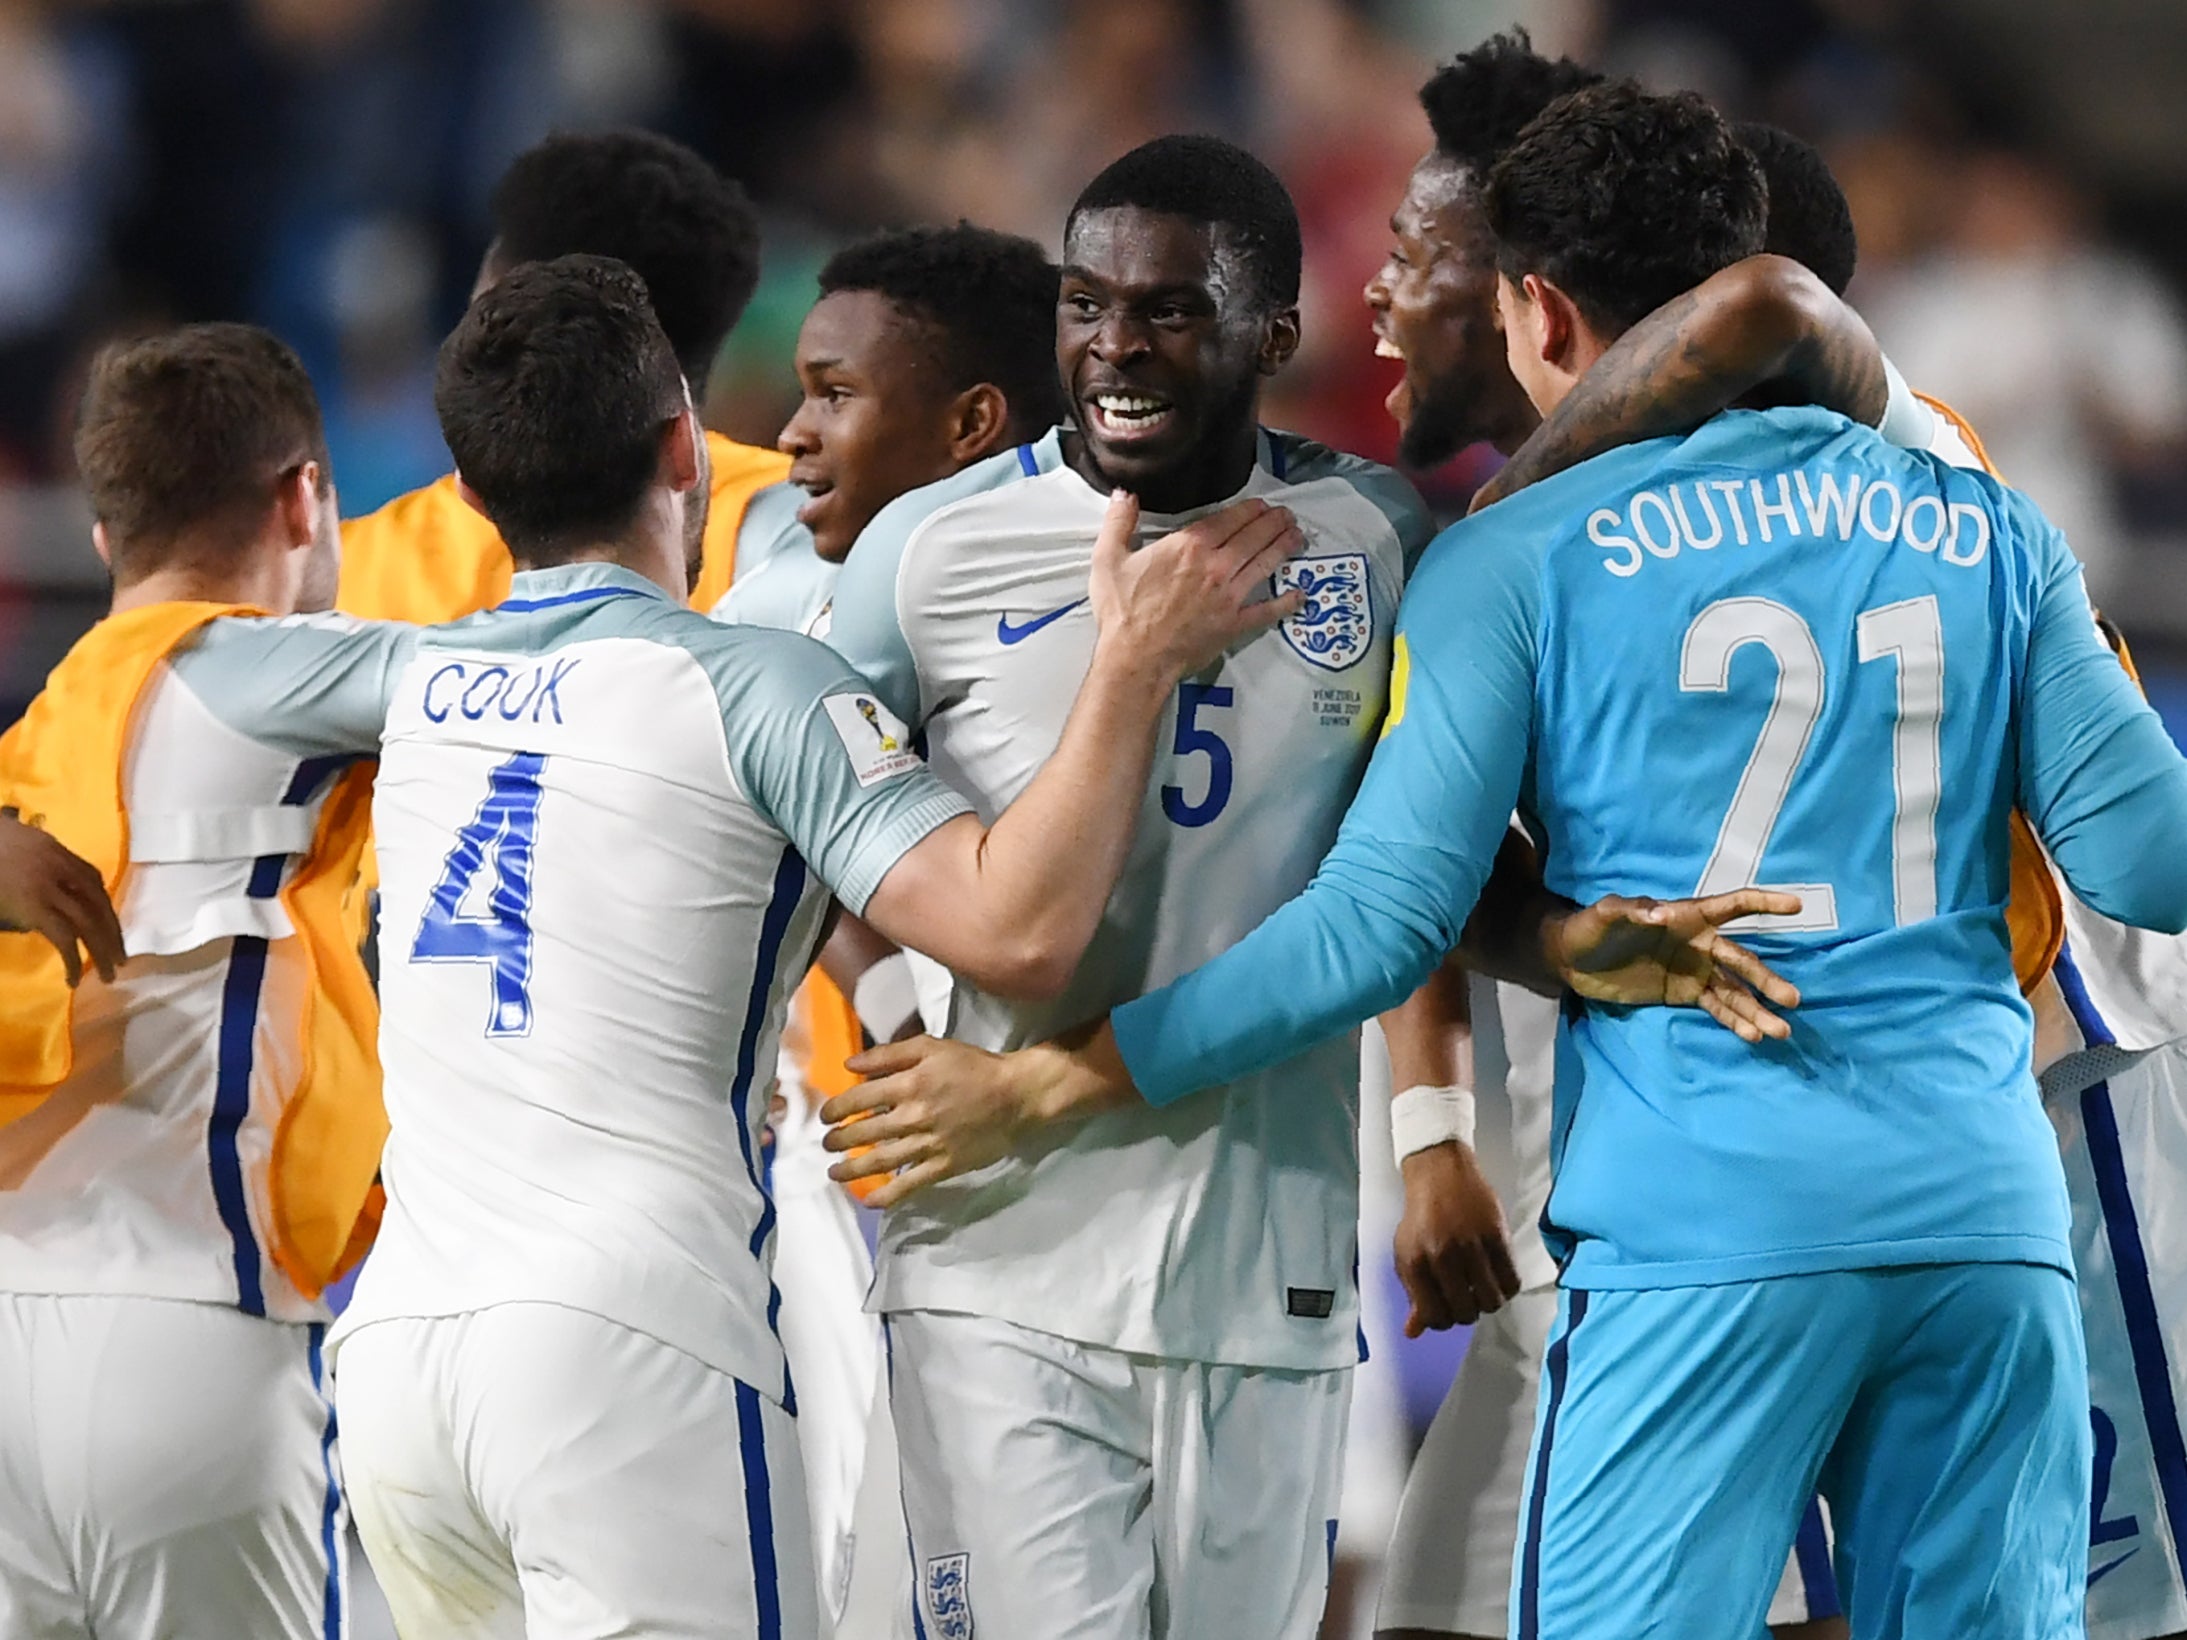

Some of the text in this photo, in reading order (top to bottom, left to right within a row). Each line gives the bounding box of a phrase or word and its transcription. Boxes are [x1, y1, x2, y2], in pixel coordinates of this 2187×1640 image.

[1586, 470, 1989, 577] SOUTHWOOD
[422, 657, 582, 725] COOK
[1161, 683, 1234, 828] 5
[1679, 594, 1944, 935] 21
[408, 750, 550, 1038] 4
